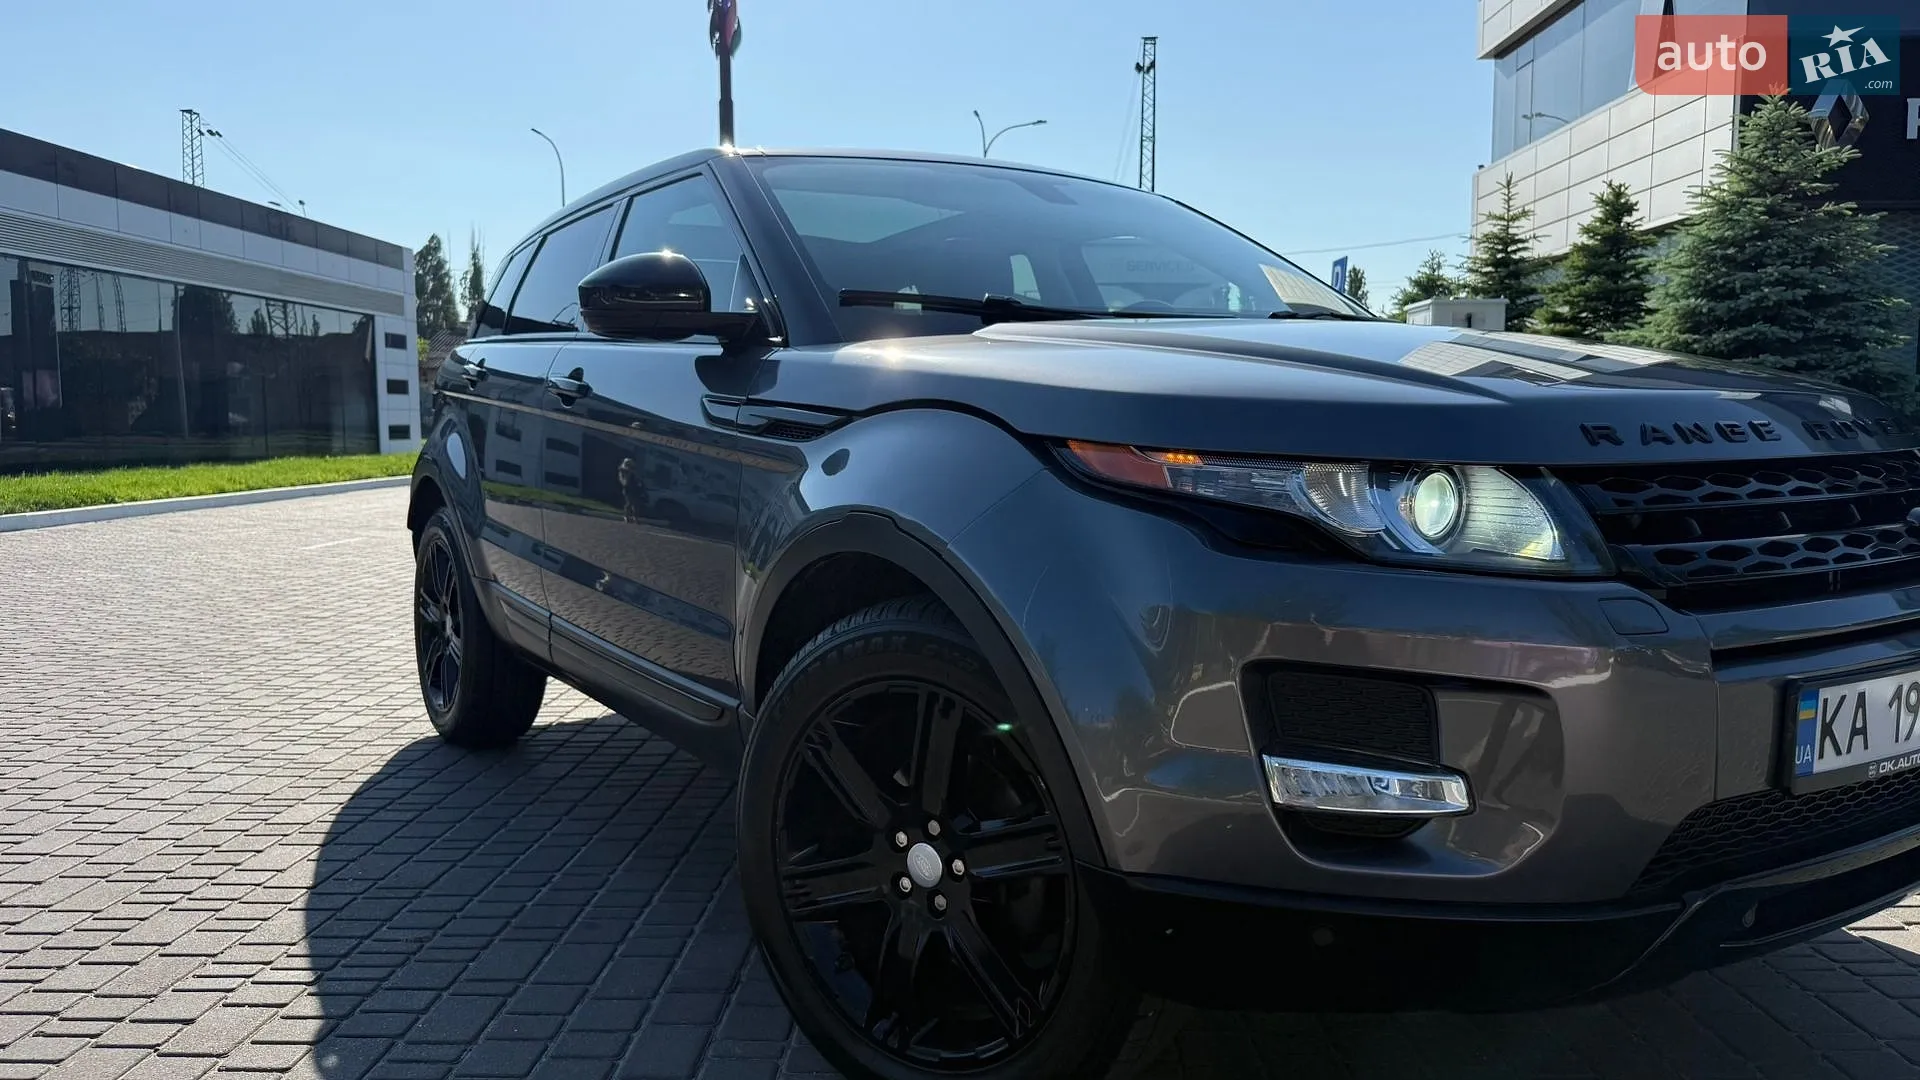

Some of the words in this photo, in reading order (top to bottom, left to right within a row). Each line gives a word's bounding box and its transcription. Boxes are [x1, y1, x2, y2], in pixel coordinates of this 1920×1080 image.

[1578, 419, 1782, 447] RANGE
[1818, 690, 1869, 760] KA
[1795, 744, 1813, 764] UA
